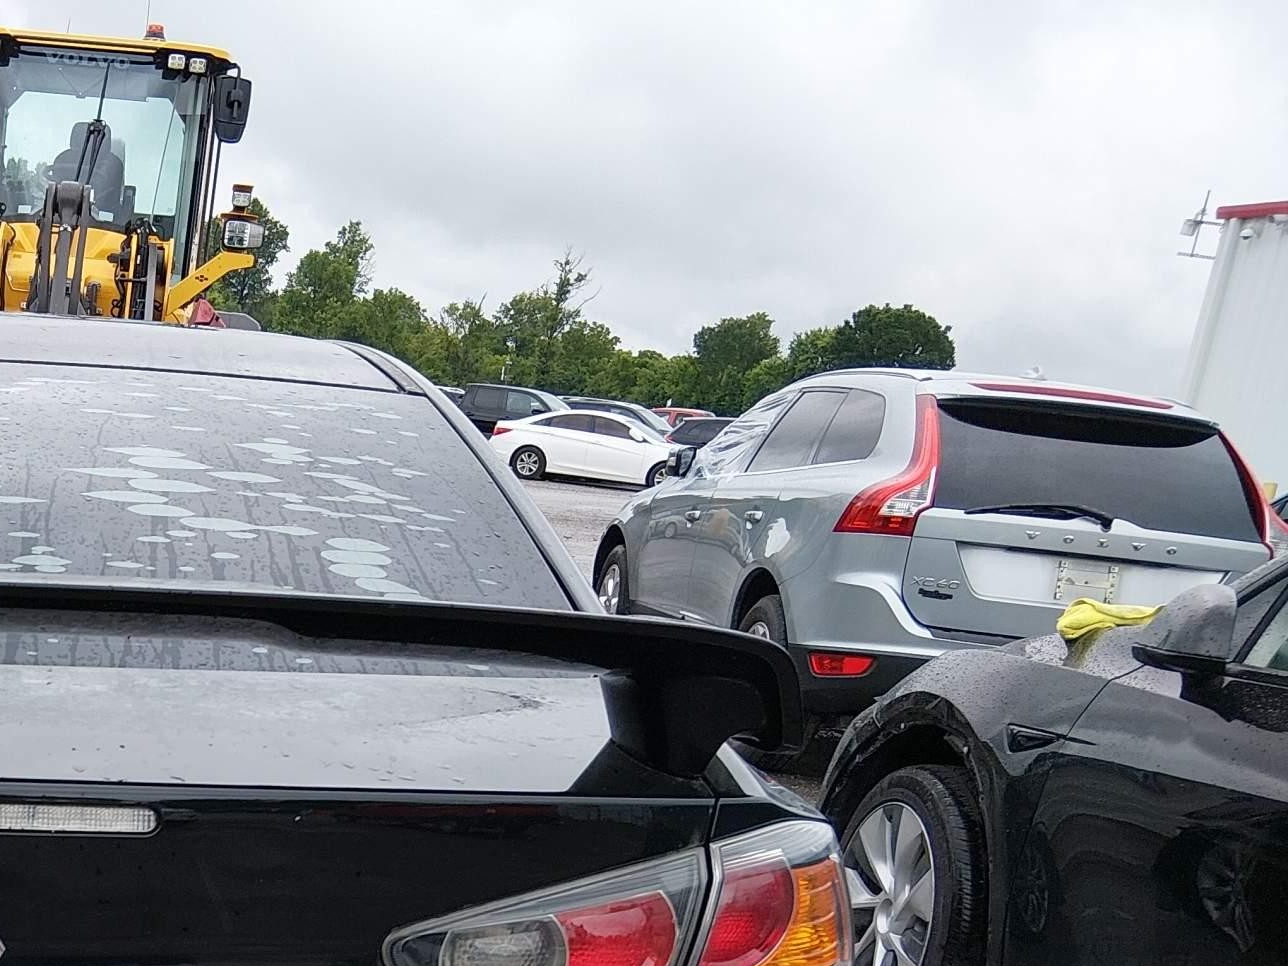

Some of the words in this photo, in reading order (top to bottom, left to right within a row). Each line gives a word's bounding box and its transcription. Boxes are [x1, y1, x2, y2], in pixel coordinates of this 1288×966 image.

[43, 50, 130, 69] VOLVO
[1025, 530, 1178, 556] VOLVO
[911, 576, 961, 590] XC60
